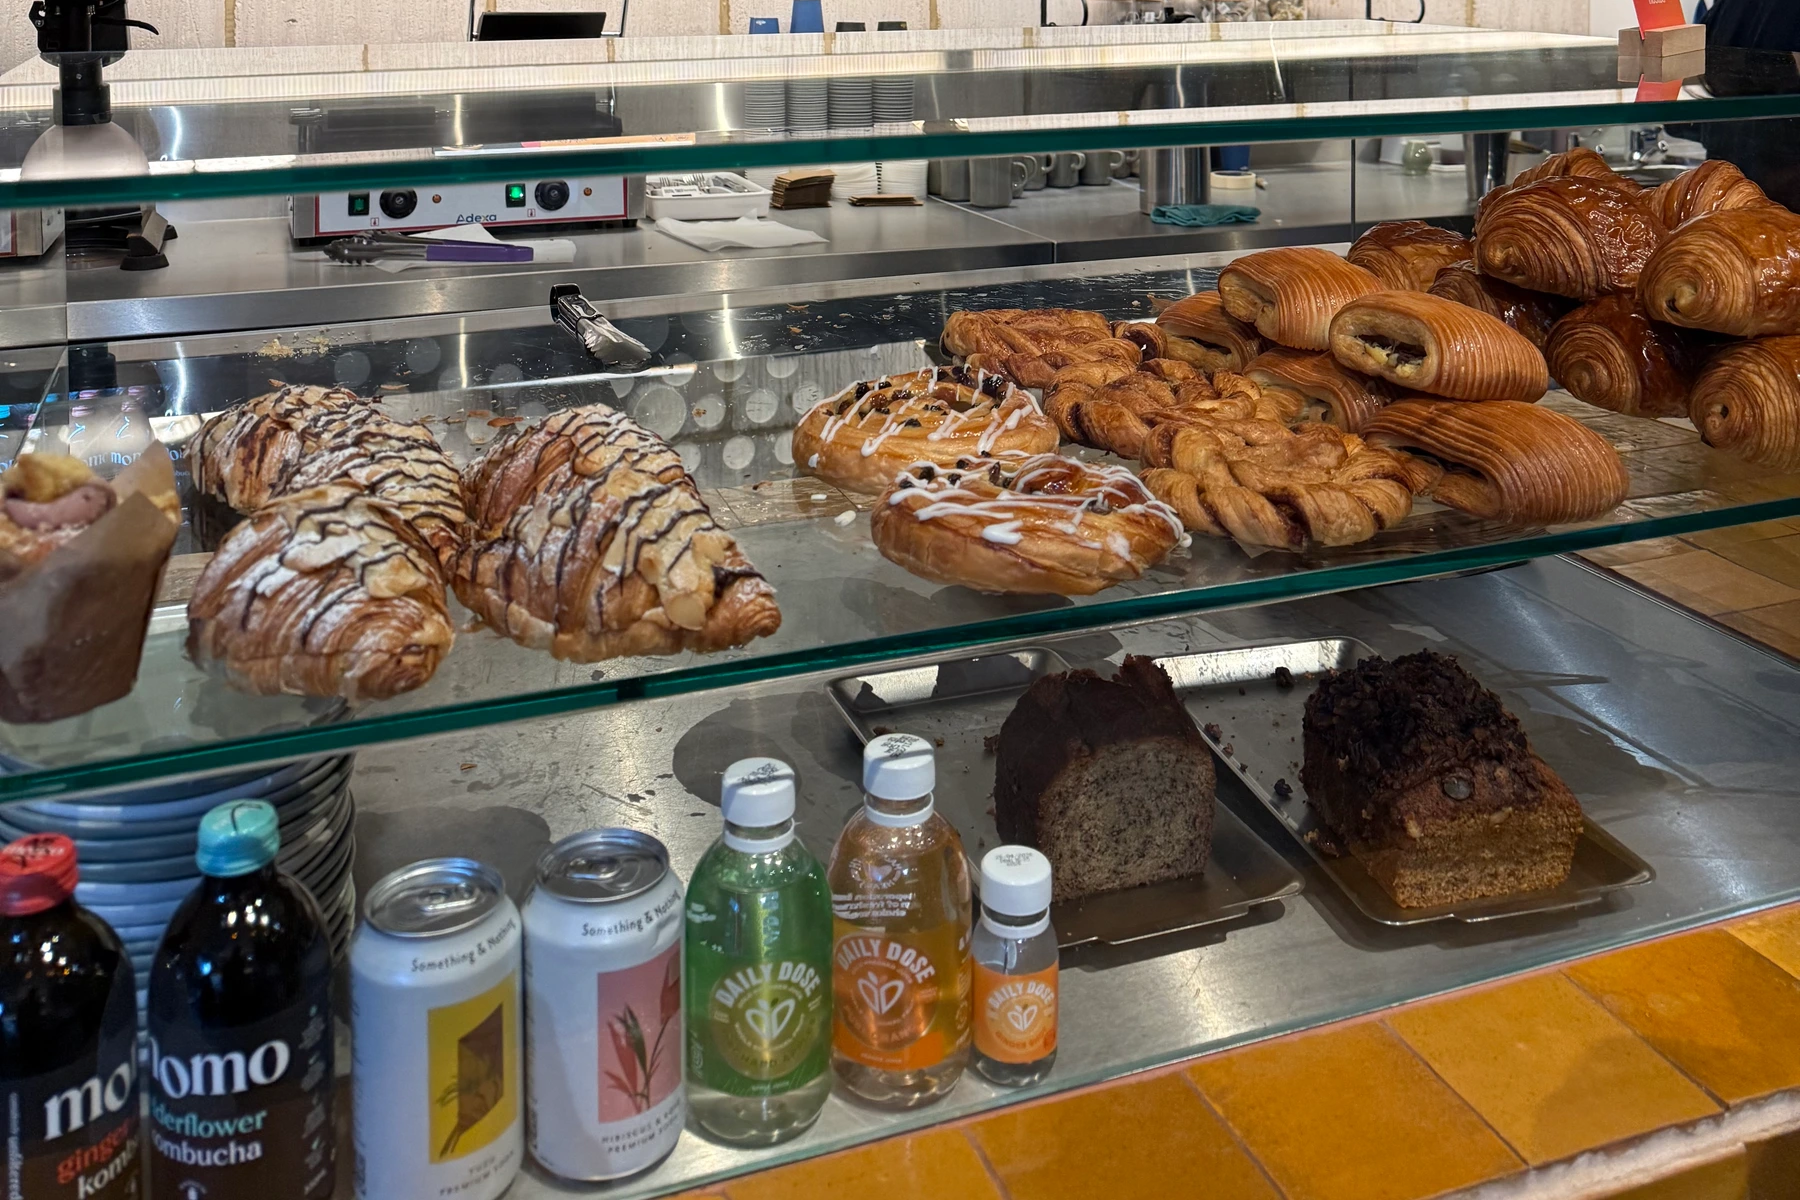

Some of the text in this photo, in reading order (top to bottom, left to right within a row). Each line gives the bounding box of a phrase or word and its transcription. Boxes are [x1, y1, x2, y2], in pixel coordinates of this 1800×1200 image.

[455, 212, 497, 224] Adexa
[581, 917, 643, 936] Something
[644, 910, 654, 924] &
[655, 888, 681, 922] Nothing
[411, 917, 517, 973] Something & Nothing
[837, 938, 881, 971] DAILY
[886, 942, 936, 984] DOSE
[714, 963, 773, 1008] DAILY
[778, 961, 821, 996] DOSE
[988, 980, 1055, 1008] DAILY DOSE
